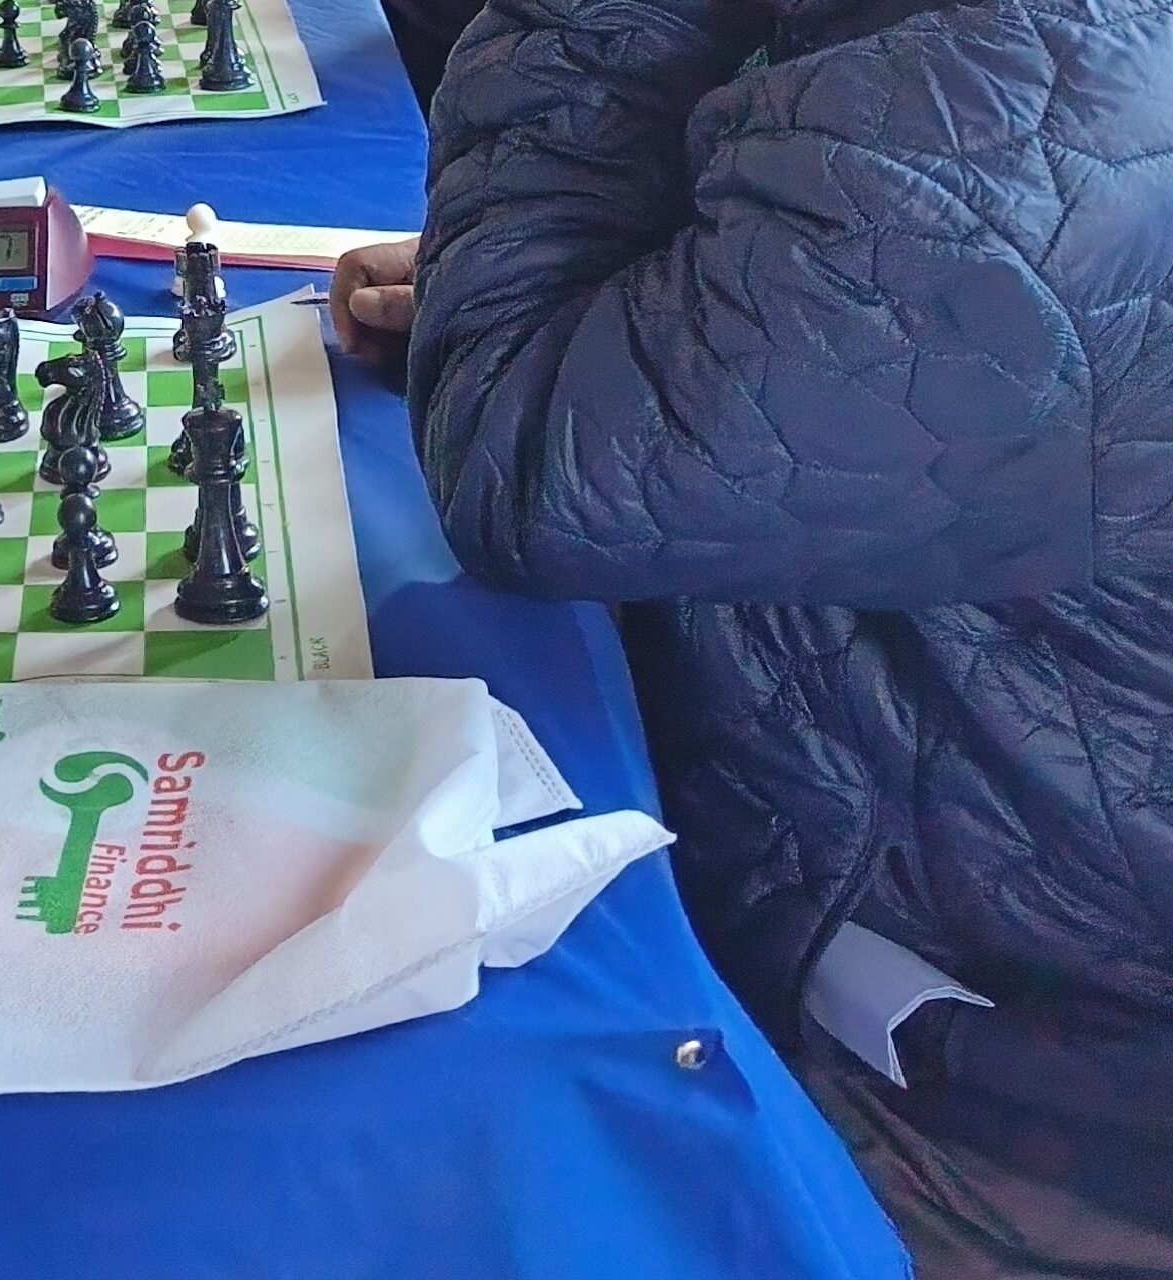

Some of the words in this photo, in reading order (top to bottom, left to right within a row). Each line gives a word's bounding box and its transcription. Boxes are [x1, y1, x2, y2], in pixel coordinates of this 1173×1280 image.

[309, 637, 330, 671] BLACK
[120, 750, 206, 933] Samriddhi
[74, 842, 126, 935] Finance
